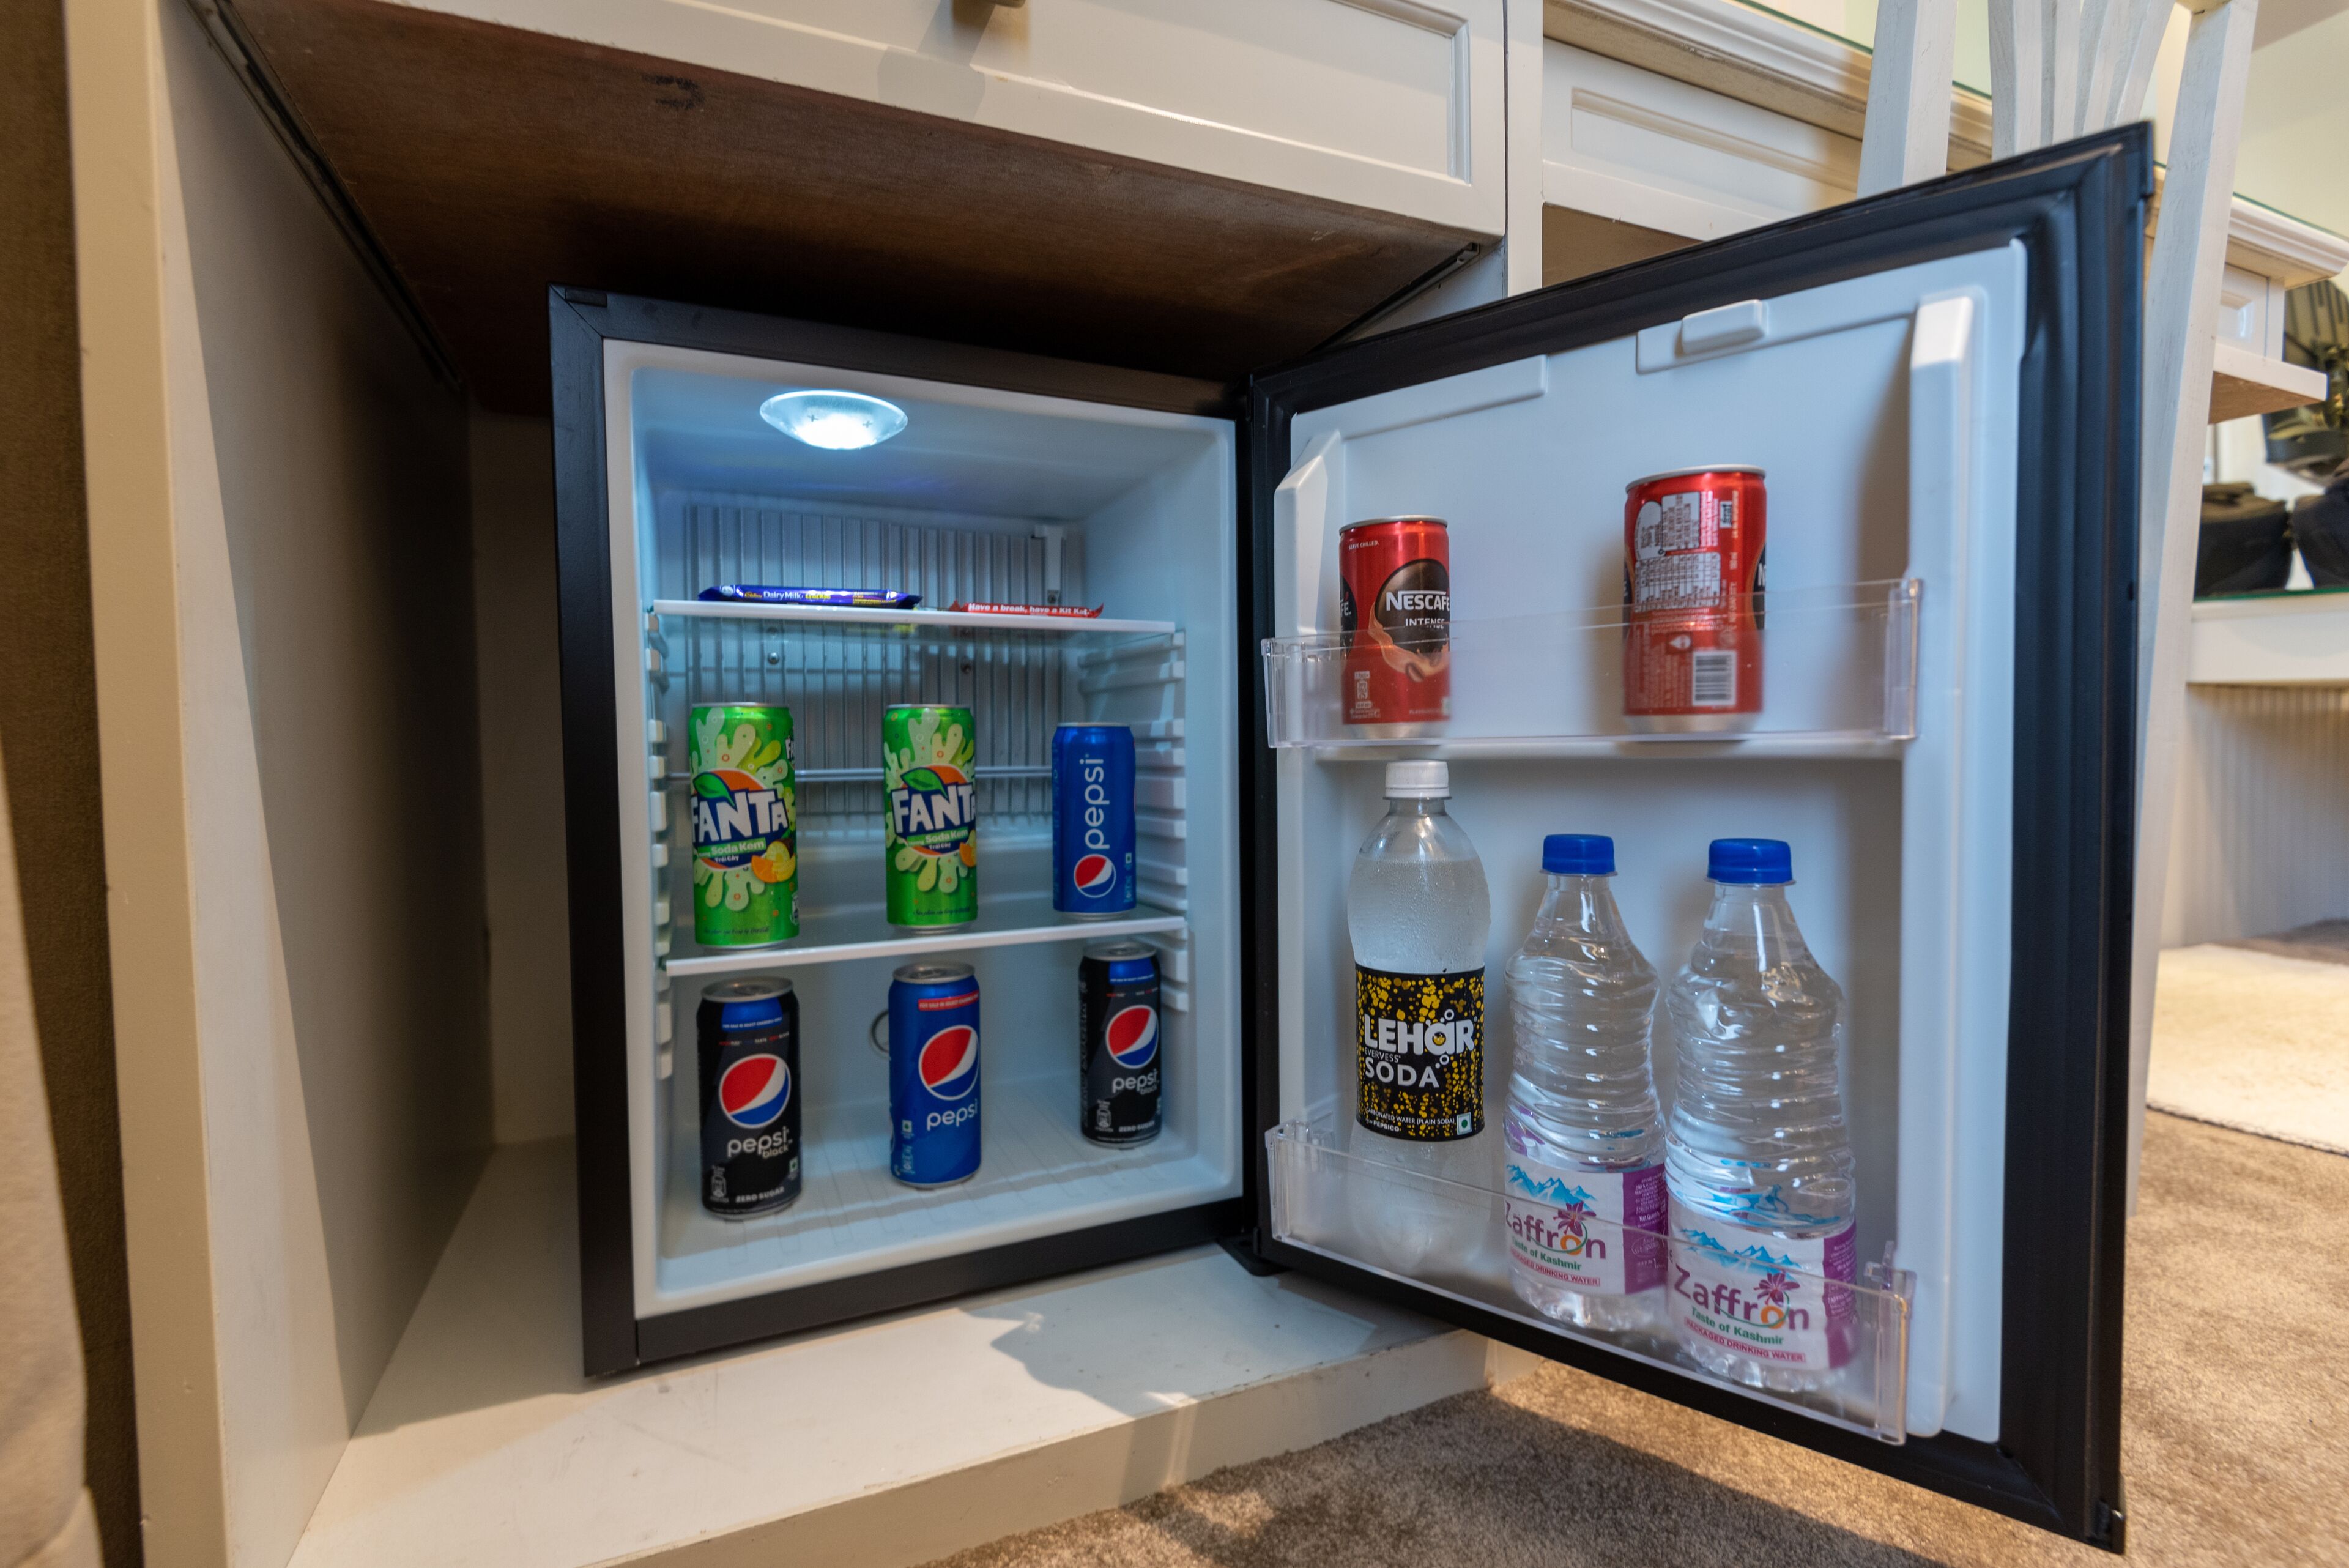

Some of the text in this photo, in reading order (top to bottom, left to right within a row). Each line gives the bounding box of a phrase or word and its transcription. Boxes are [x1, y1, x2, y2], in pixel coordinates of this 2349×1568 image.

[763, 591, 784, 600] Dairy
[1405, 618, 1445, 627] INTENSE
[1080, 758, 1110, 849] pepsi
[926, 833, 950, 843] Soda
[951, 830, 968, 839] Kem
[711, 844, 738, 855] Soda
[739, 841, 765, 851] Kem
[1112, 1068, 1157, 1093] pepsi
[1365, 1057, 1439, 1088] SODA
[927, 1099, 978, 1131] pepsi
[1366, 1107, 1395, 1121] CARBONATED
[1373, 1120, 1400, 1131] PEPSICO
[727, 1126, 787, 1158] pepsi
[762, 1145, 789, 1159] black
[736, 1194, 757, 1203] ZERO
[759, 1186, 785, 1200] SUGAR
[1540, 1253, 1582, 1271] Kashmir
[1536, 1265, 1569, 1280] DRINKING
[1570, 1276, 1597, 1285] WATER
[1674, 1264, 1809, 1331] Zaffron
[1692, 1306, 1784, 1345] Taste of Kashmir
[1687, 1320, 1803, 1361] PACKAGED DRINKING WATER
